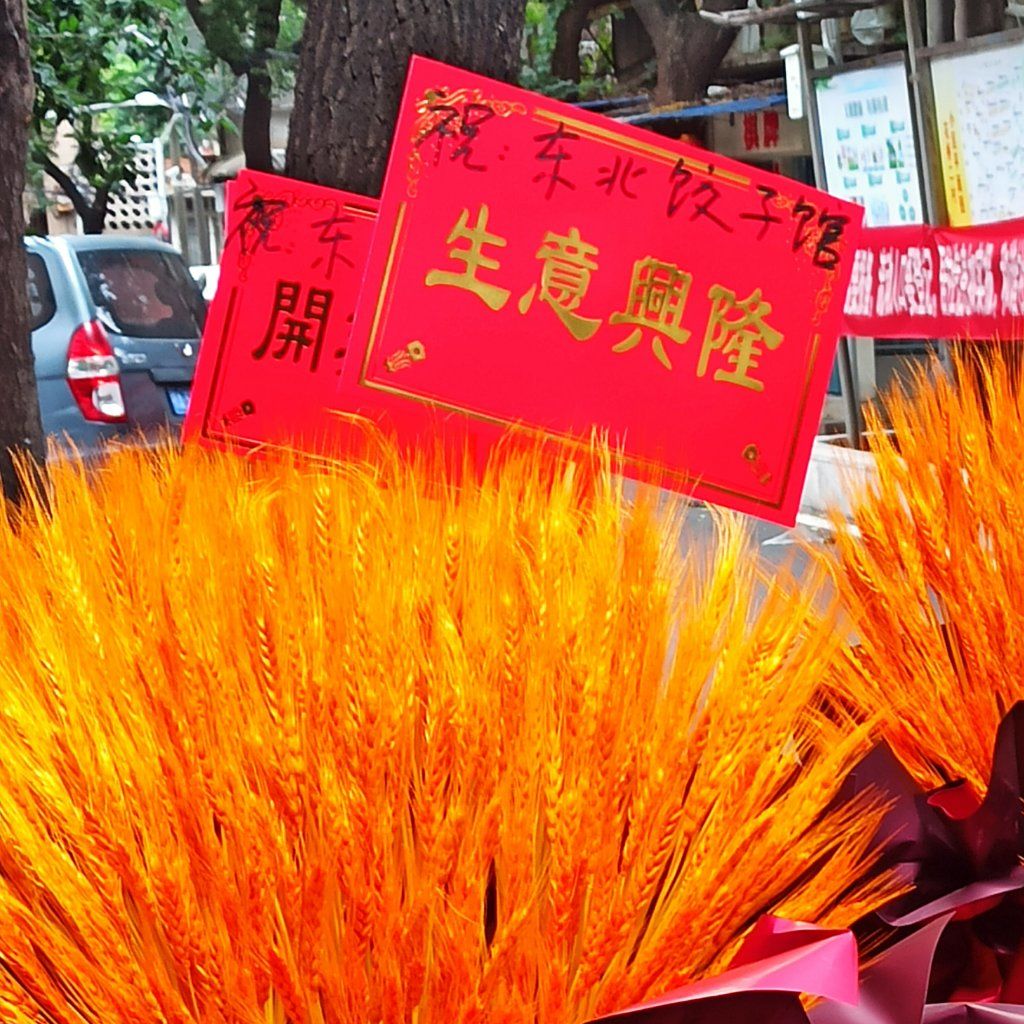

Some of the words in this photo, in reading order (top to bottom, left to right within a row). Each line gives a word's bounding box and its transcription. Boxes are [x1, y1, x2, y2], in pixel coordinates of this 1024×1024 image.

[252, 279, 354, 376] 開
[424, 203, 785, 392] 生意興隆
